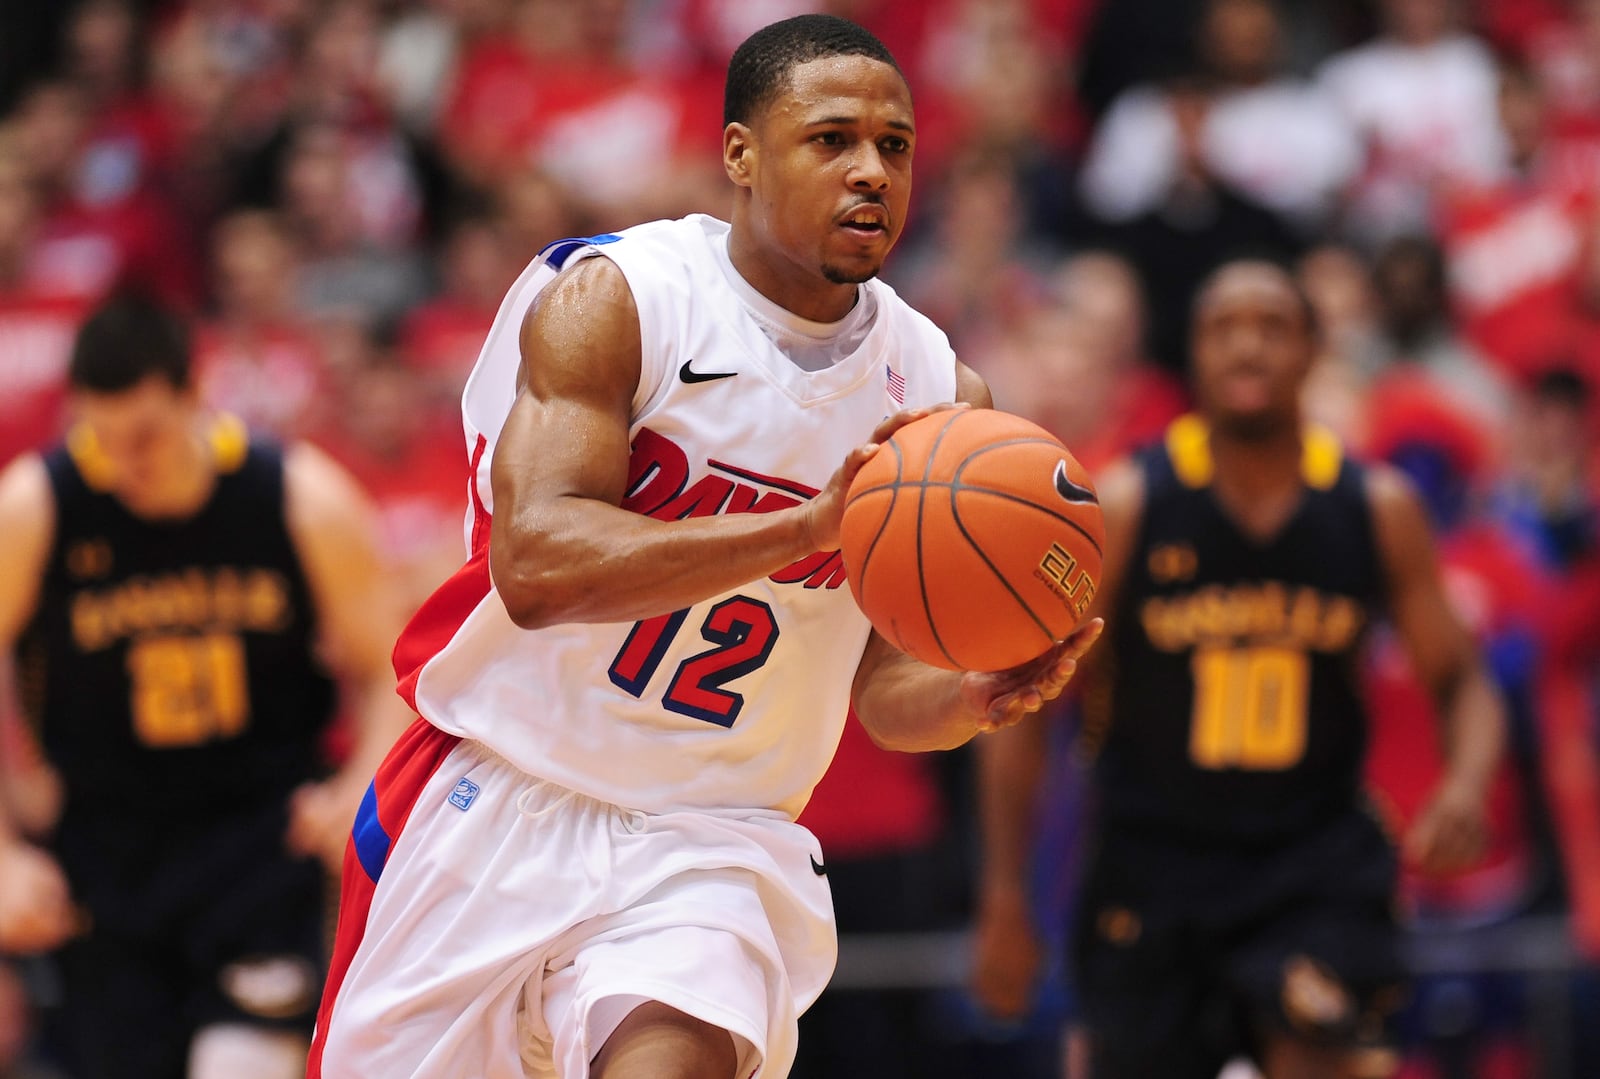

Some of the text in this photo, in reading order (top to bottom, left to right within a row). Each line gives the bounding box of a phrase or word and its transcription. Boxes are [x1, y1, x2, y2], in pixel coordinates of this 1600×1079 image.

[1040, 541, 1095, 616] ELITE
[128, 635, 248, 745] 21
[607, 594, 780, 729] 12
[1190, 647, 1310, 770] 10
